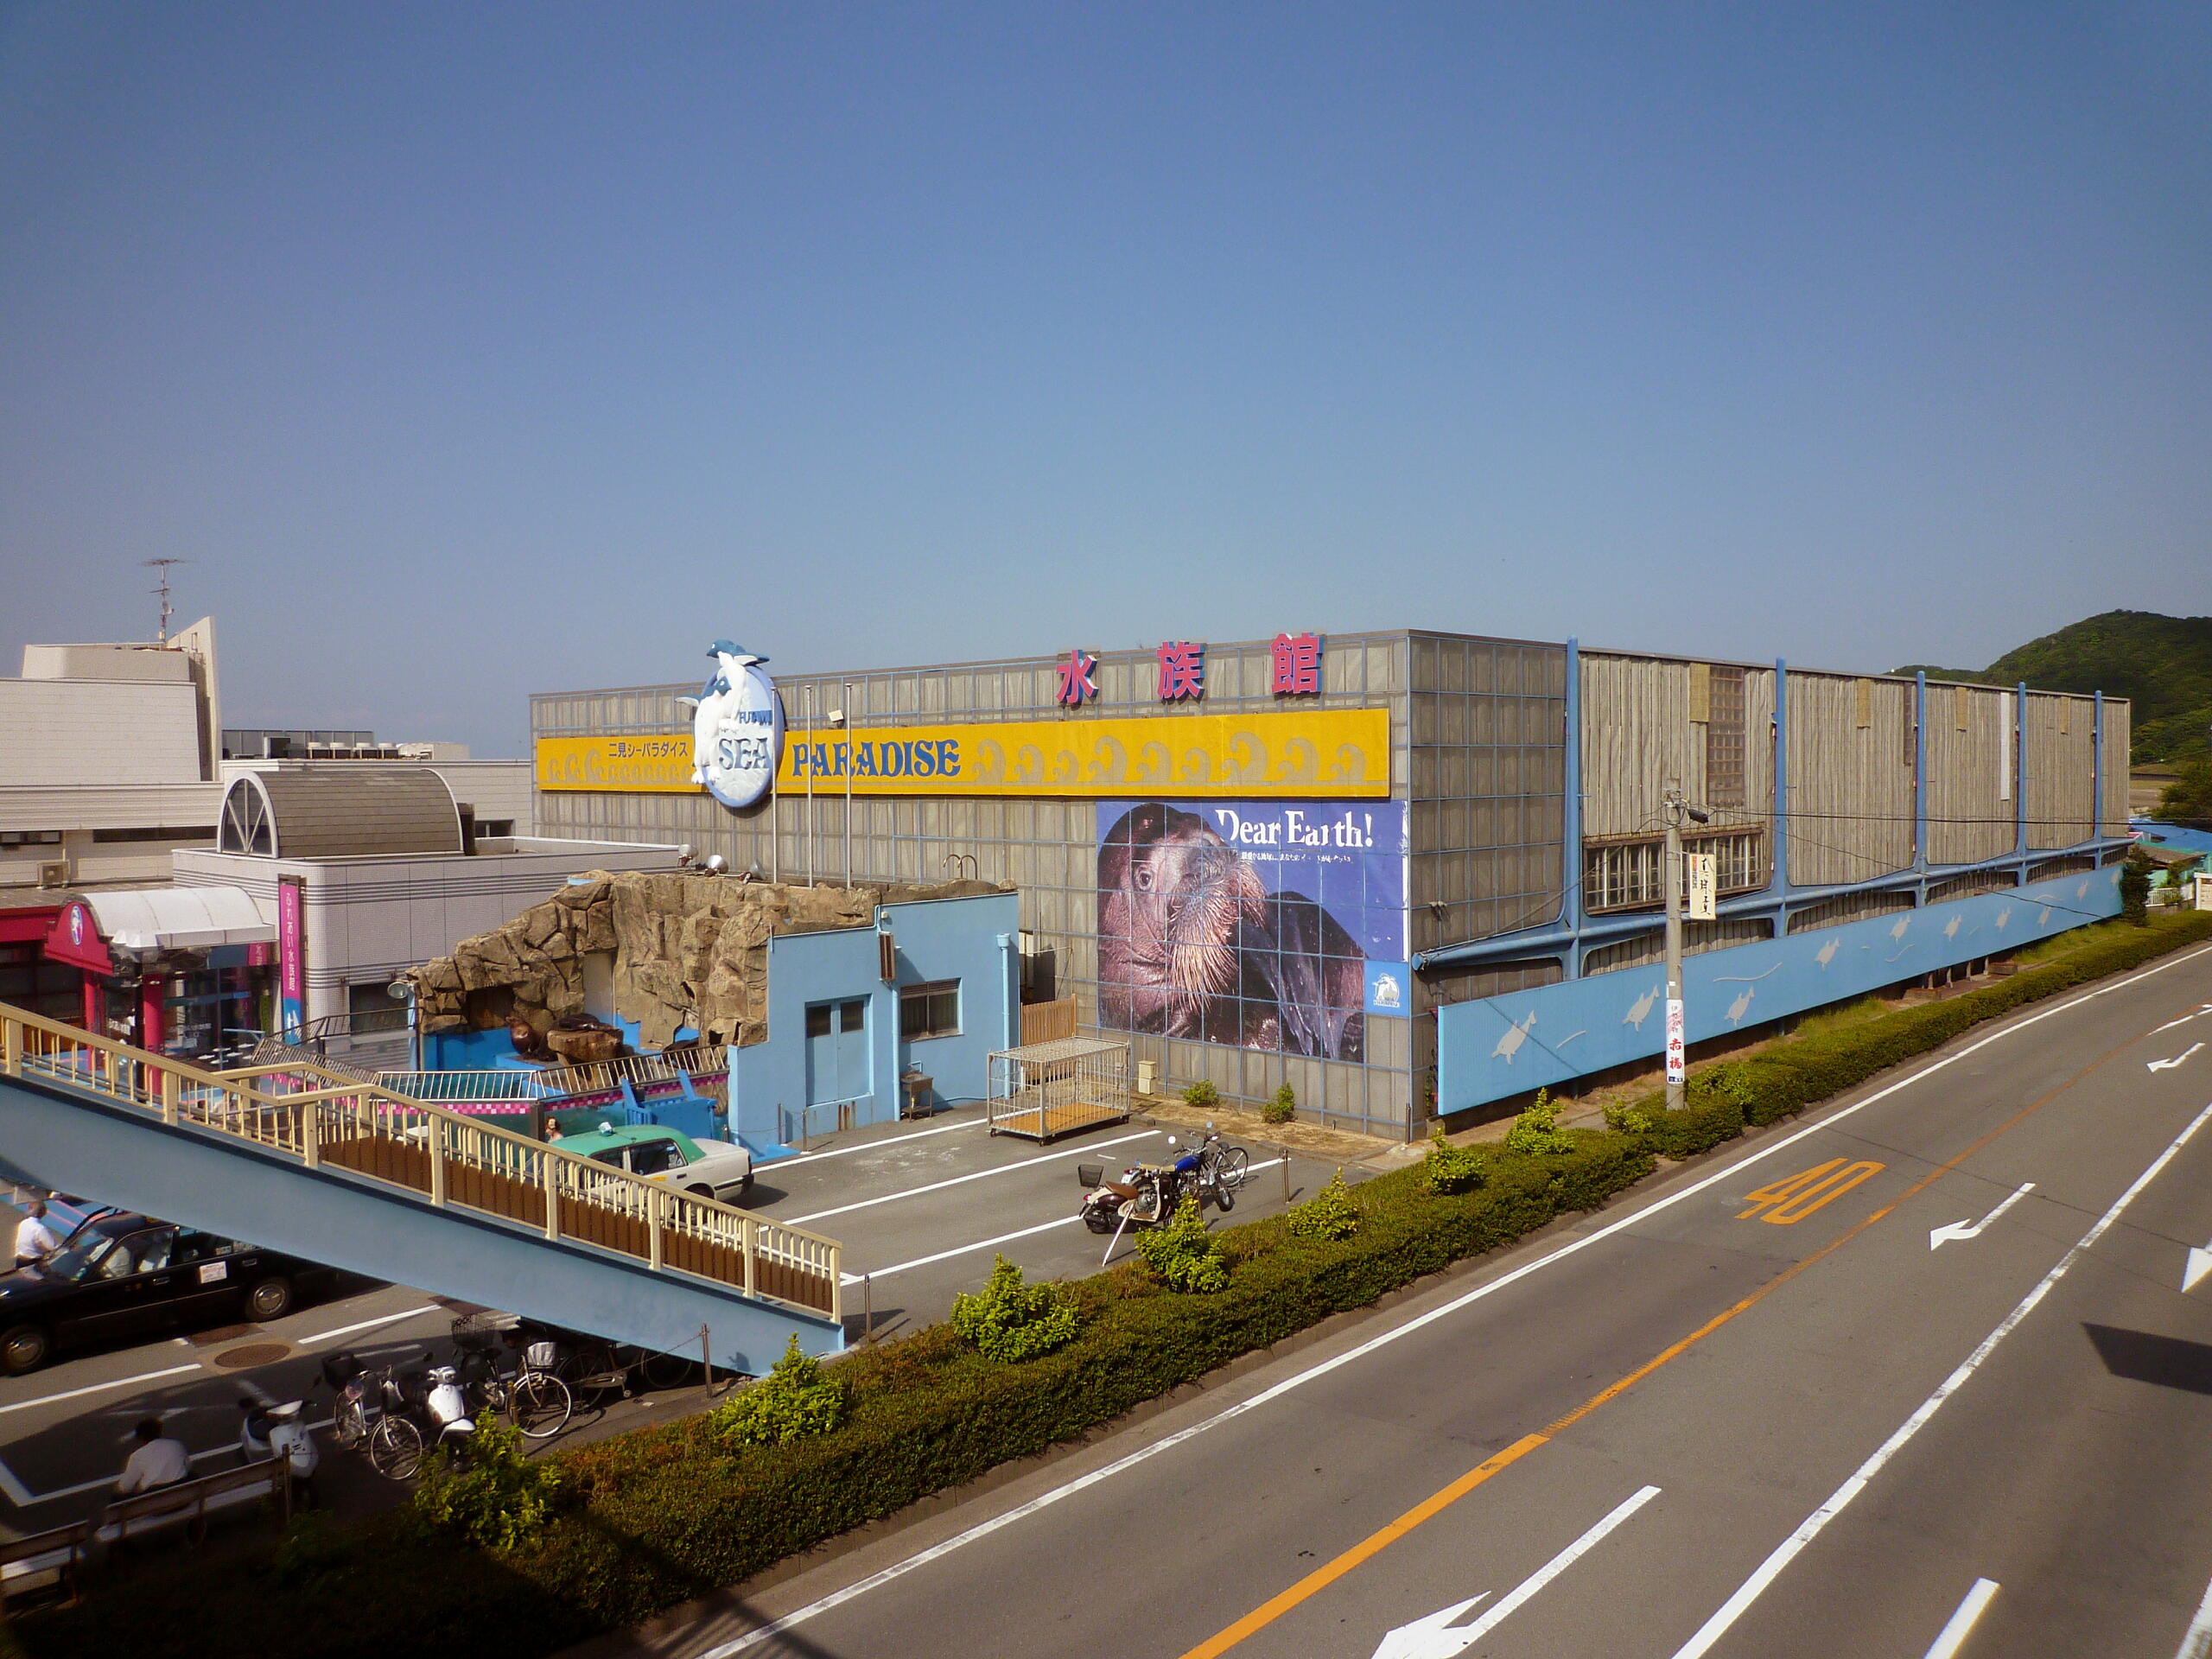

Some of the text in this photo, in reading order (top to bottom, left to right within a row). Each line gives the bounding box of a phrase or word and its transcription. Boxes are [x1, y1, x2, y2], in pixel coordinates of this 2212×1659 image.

[1056, 632, 1324, 704] 水族館
[719, 737, 961, 778] SEA PARADISE
[1215, 809, 1373, 848] Dear Earth!
[1669, 1038, 1682, 1070] 赤福
[1734, 1157, 1886, 1224] 40
